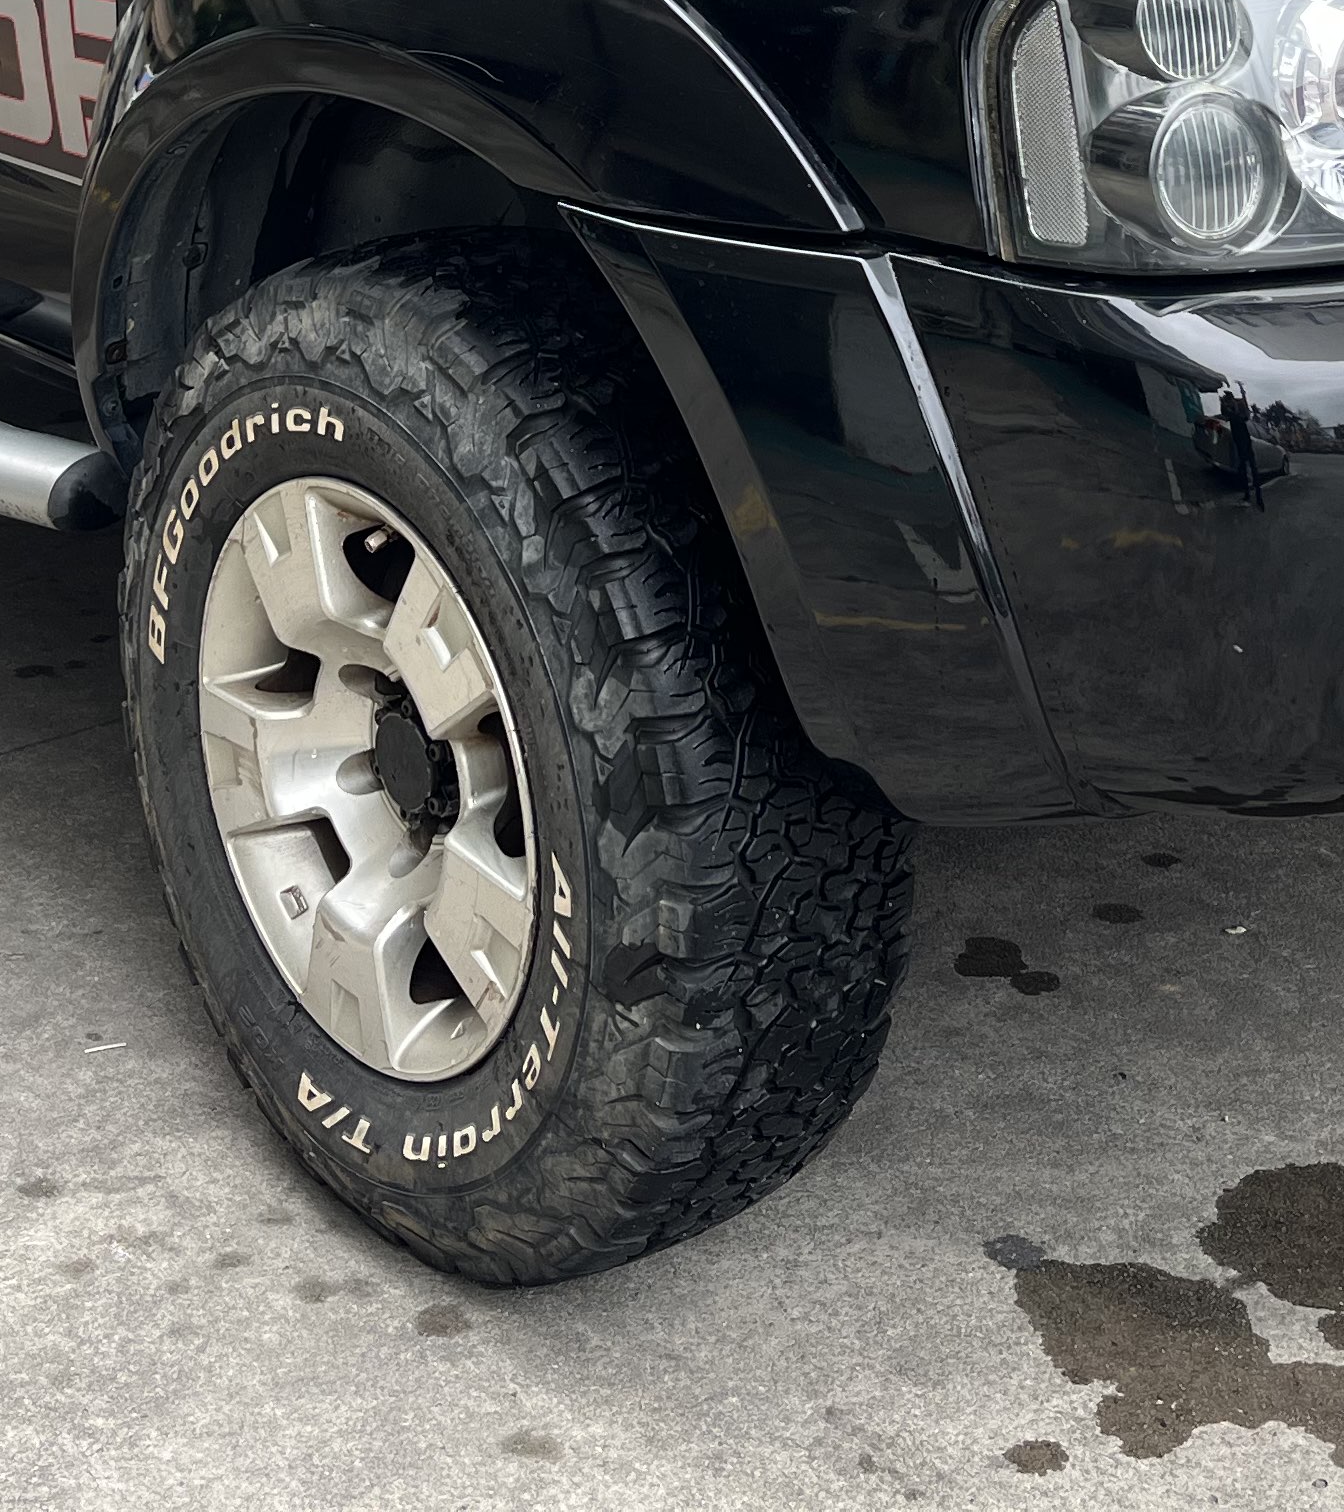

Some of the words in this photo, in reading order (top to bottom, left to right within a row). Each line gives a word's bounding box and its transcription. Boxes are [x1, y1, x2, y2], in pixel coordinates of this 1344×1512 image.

[148, 403, 346, 665] BFGoodrich
[296, 1071, 372, 1154] T/A
[402, 851, 573, 1169] All-Terrain
